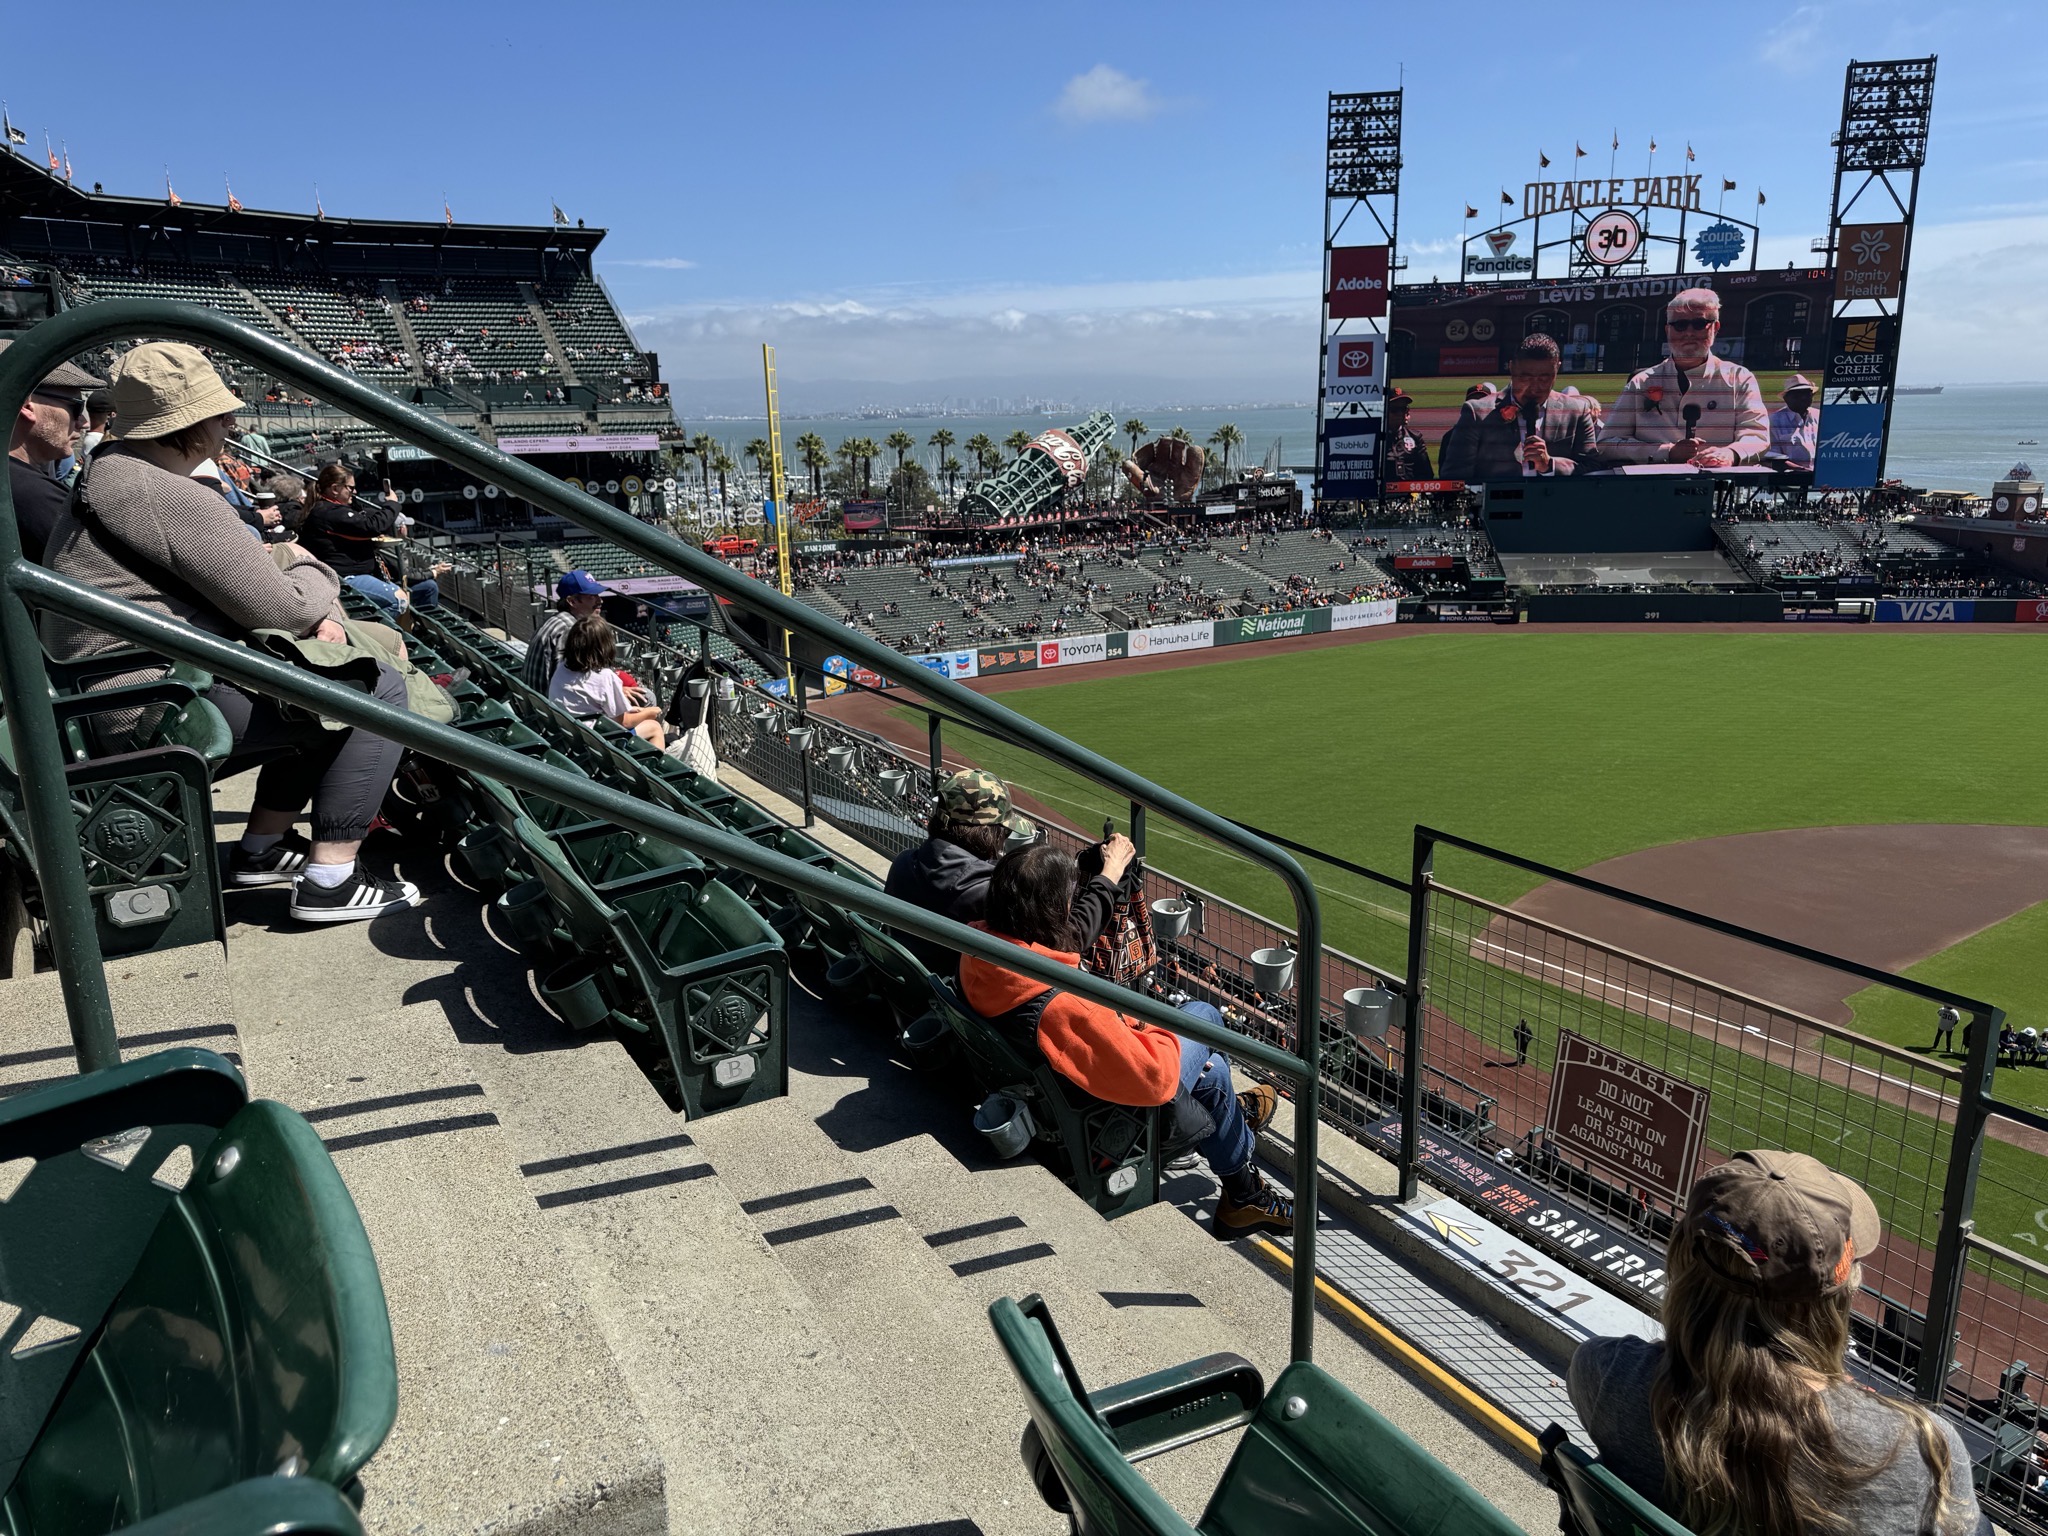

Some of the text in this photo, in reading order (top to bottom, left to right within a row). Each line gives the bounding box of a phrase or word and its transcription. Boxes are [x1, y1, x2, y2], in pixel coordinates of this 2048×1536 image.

[1523, 174, 1702, 218] ORACLE PARK
[1701, 231, 1741, 245] coupa
[1467, 255, 1532, 272] Fanatics
[1336, 277, 1382, 291] Adobe
[1843, 270, 1891, 284] Dignity
[1603, 277, 1713, 300] LANDING
[1844, 284, 1887, 296] Health
[1450, 325, 1465, 336] 24
[1476, 325, 1491, 335] 30
[1834, 354, 1883, 364] CACHE
[1834, 365, 1880, 375] CREEK
[1329, 384, 1380, 396] TOYOTA
[1335, 441, 1369, 450] StubHub
[1819, 431, 1880, 449] Alaska
[388, 447, 415, 460] Cuervo
[1329, 460, 1373, 470] 100% VERIFIED
[1327, 471, 1374, 480] GIANTS TICKETS
[467, 488, 473, 496] 3
[628, 482, 637, 490] 30
[665, 481, 675, 489] 44
[1410, 482, 1441, 491] $6,950
[1412, 558, 1436, 566] Adobe
[1896, 602, 1955, 621] VISA
[1256, 616, 1305, 632] National
[1150, 631, 1209, 646] Hanwha Life
[1063, 643, 1103, 656] TOYOTA
[1107, 648, 1122, 657] 354
[129, 892, 152, 914] C
[727, 1061, 742, 1079] B
[1585, 1048, 1675, 1102] PLEASE
[1599, 1079, 1654, 1115] DO NOT
[1577, 1095, 1667, 1146] LEAN, SIT ON
[1585, 1115, 1653, 1156] OR STAND
[1569, 1123, 1665, 1179] AGAINST RAIL
[1118, 1173, 1129, 1188] A
[1495, 1184, 1539, 1206] HOME
[1481, 1190, 1526, 1216] OF THE
[1527, 1209, 1600, 1248] SAN
[1499, 1249, 1594, 1313] 321
